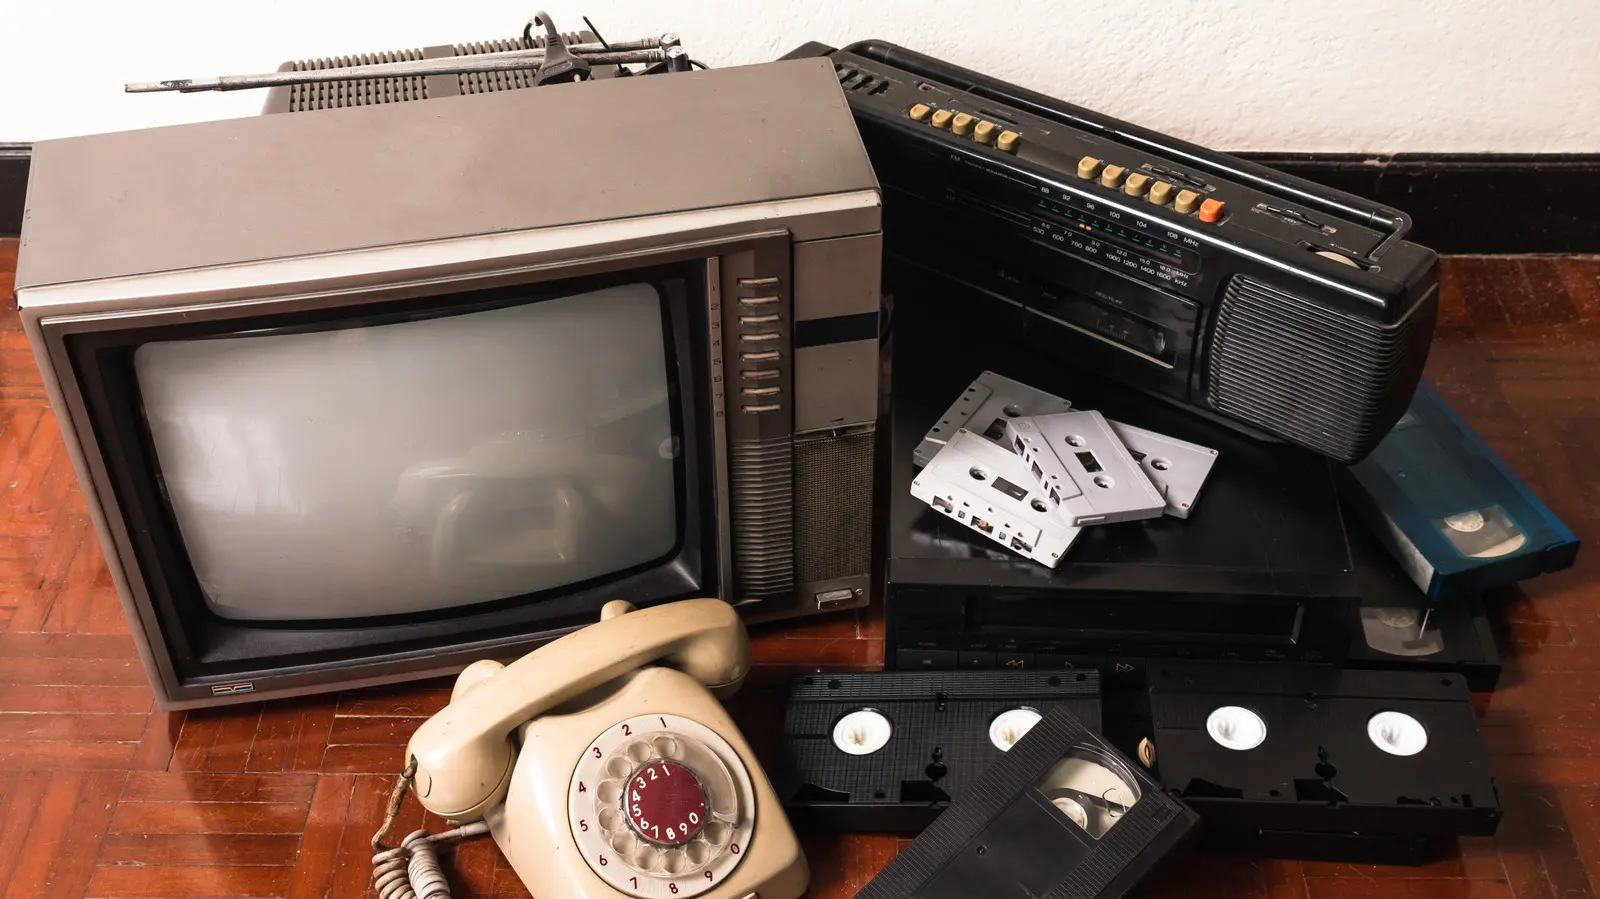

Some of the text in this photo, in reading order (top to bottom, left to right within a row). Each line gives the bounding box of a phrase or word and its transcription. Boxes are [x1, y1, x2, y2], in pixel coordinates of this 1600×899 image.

[1041, 186, 1050, 194] 88
[1086, 202, 1095, 210] 96
[1109, 211, 1120, 219] 100
[1136, 220, 1147, 229] 104
[1167, 231, 1179, 240] 108
[1183, 237, 1199, 248] MHz
[1032, 226, 1188, 287] 530 600 700 800 1000 1200 1400 1600 kHz
[1116, 249, 1128, 257] 12.0
[1139, 257, 1151, 265] 15.0
[1159, 264, 1171, 272] 18.0
[1176, 270, 1189, 279] MHz
[710, 303, 719, 311] 2
[578, 717, 740, 894] 1 2 3 4 5 6 7 8 9 0
[632, 764, 698, 840] 1 2 3 4 5 6 7 8 9 0
